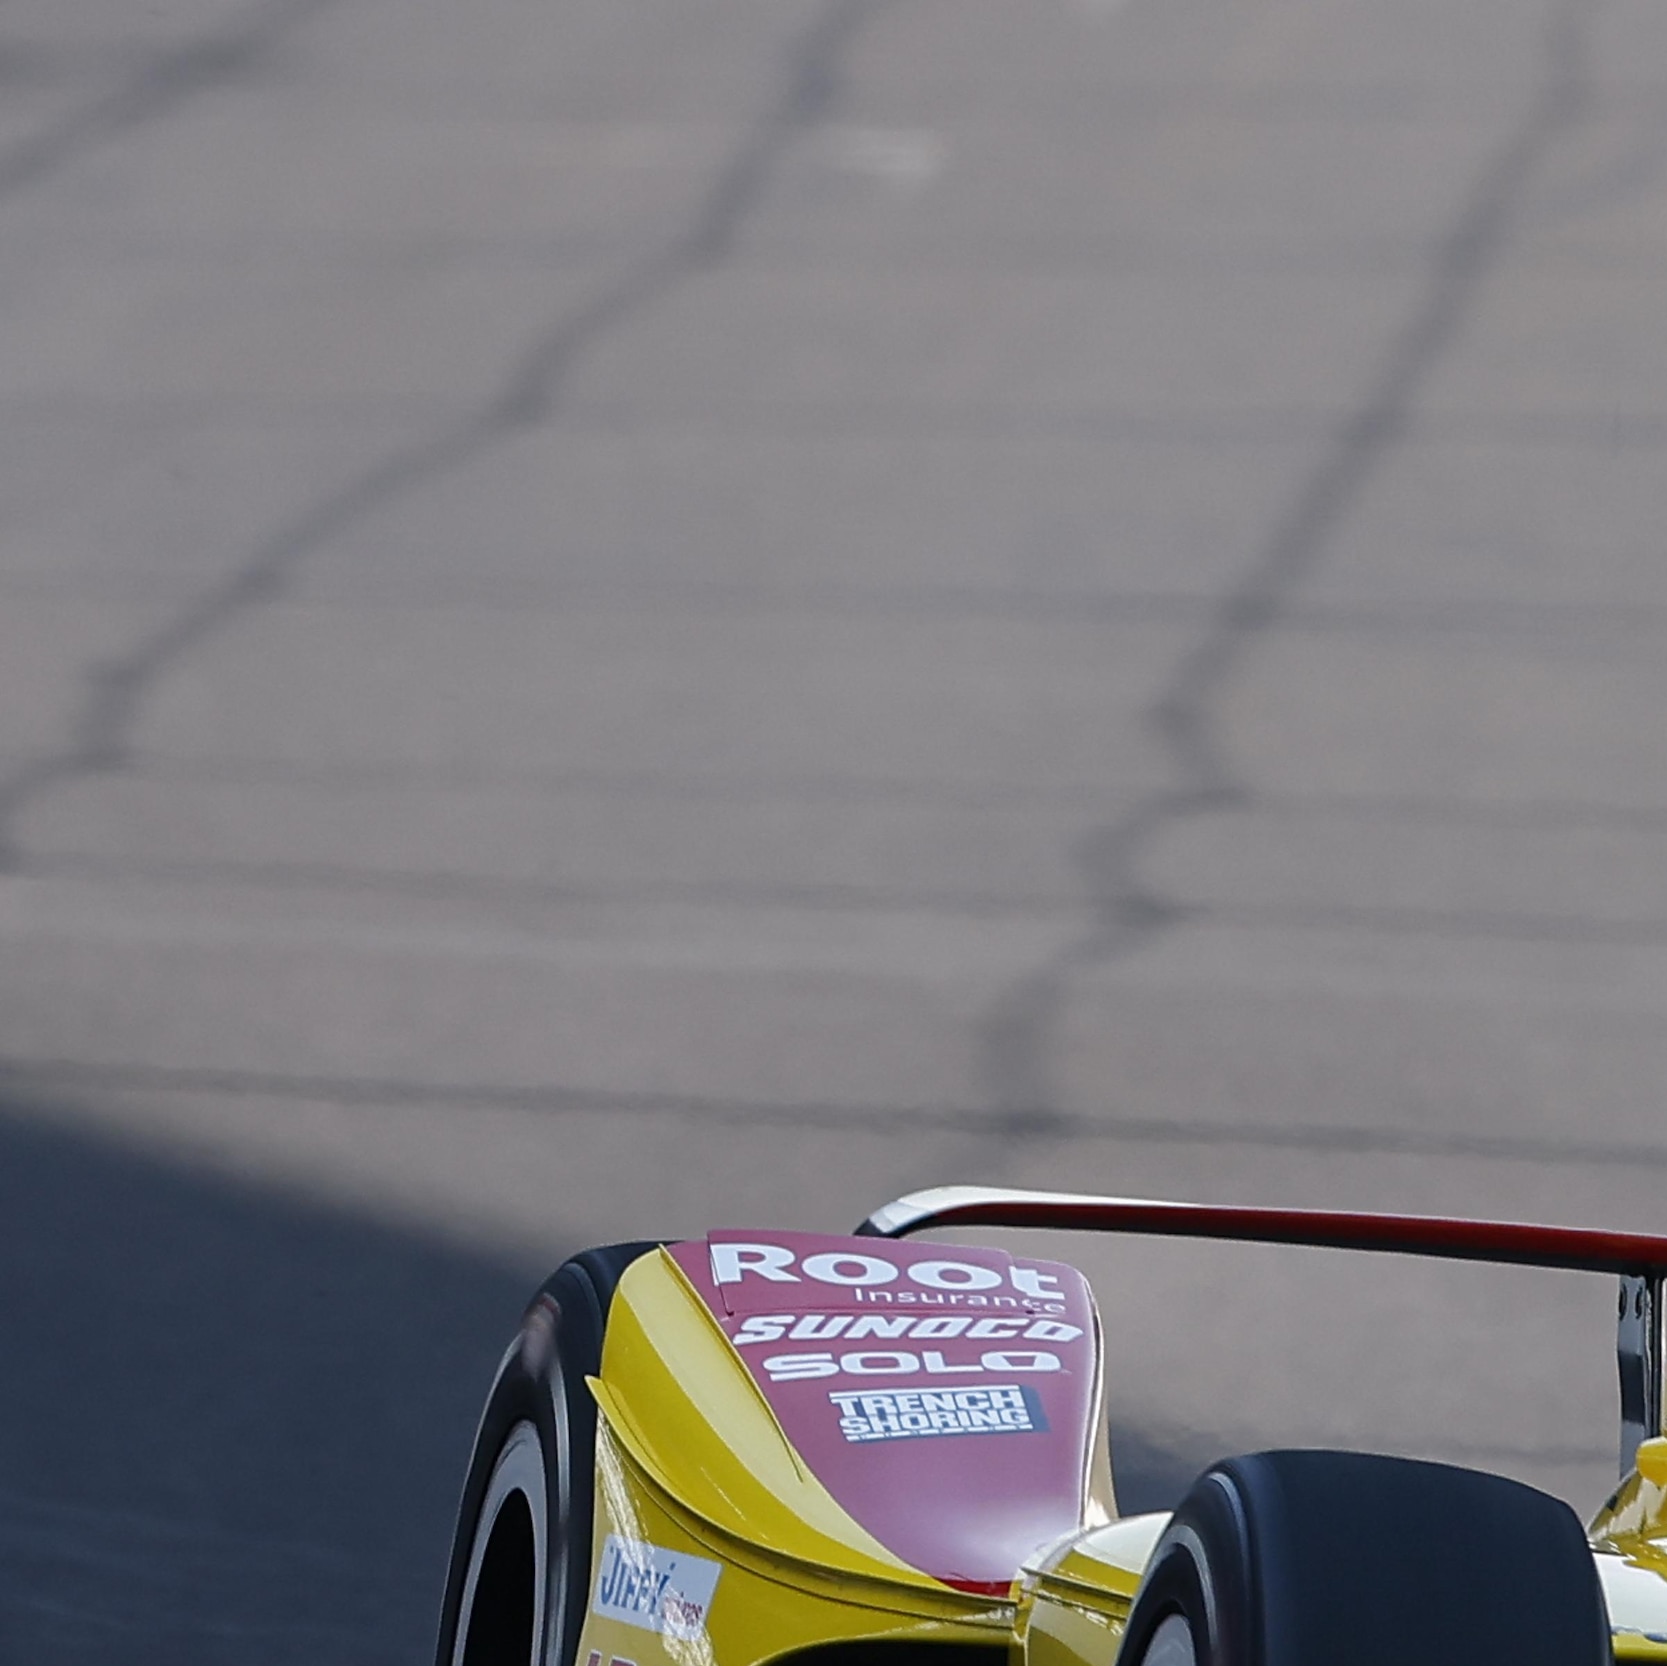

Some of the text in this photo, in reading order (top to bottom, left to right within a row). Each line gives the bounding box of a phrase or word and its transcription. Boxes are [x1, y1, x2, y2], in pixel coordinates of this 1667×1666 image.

[855, 1287, 1067, 1314] Insurance
[732, 1314, 1085, 1346] SUNOCO
[762, 1350, 1062, 1382] SOLO
[829, 1390, 1026, 1418] TRENCH
[838, 1408, 1032, 1435] SHORING
